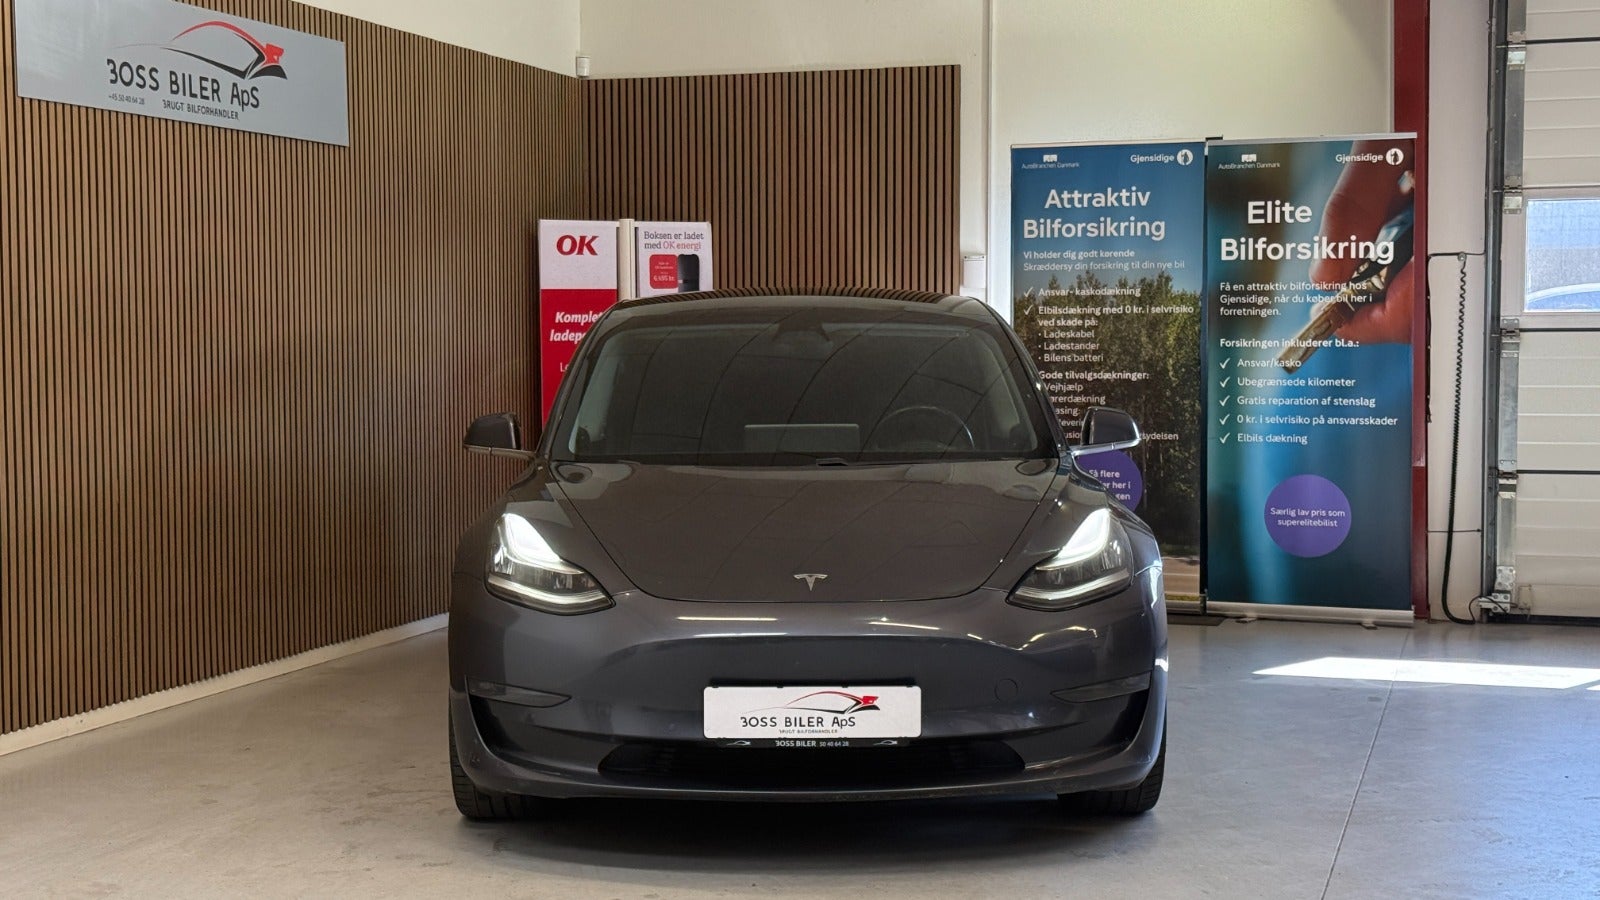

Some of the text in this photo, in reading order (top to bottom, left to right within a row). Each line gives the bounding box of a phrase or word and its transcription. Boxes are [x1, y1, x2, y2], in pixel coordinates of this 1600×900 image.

[168, 70, 221, 102] BILER
[231, 82, 260, 112] ApS
[187, 103, 240, 120] BILFORHANDLER
[1130, 153, 1175, 164] Gjensidige
[1336, 154, 1383, 164] Gjensidige
[1044, 186, 1151, 209] Attraktiv
[1247, 200, 1313, 224] Elite
[1023, 215, 1166, 241] Bilforsikring
[643, 231, 673, 240] Boksen
[684, 231, 705, 240] ladet
[556, 234, 600, 256] OK
[644, 241, 702, 252] med OK energi
[1220, 236, 1394, 265] Bilforsikring
[1024, 249, 1135, 261] Vi holder dig godt kørende
[1023, 260, 1185, 272] Skræddersy din forsikring til din nye bil
[1038, 287, 1141, 297] Ansvar- kaskodækning
[1220, 282, 1232, 291] Få
[1246, 282, 1288, 291] attraktiv
[1290, 282, 1346, 292] bilforsikring
[1350, 282, 1367, 290] hos
[1220, 294, 1272, 304] Gjensidige,
[1274, 294, 1290, 303] når
[1292, 294, 1304, 302] du
[1306, 294, 1334, 302] køber
[1336, 294, 1348, 302] bil
[1350, 294, 1368, 302] her
[1038, 306, 1101, 316] Elbilsdækning
[1102, 306, 1123, 314] med
[1125, 306, 1131, 314] 0
[1132, 306, 1144, 314] kr.
[1151, 306, 1194, 314] selvrisiko
[1220, 307, 1282, 317] forretningen.
[1038, 318, 1098, 328] ved skade på:
[1044, 330, 1095, 338] Ladeskabel
[1044, 342, 1100, 350] Ladestander
[1220, 338, 1280, 349] Forsikringen
[1282, 338, 1333, 348] inkluderer
[1237, 358, 1302, 368] Ansvar/kasko
[1038, 370, 1150, 381] Gode tilvalgsdækninger:
[1238, 377, 1356, 388] Ubegrænsede kilometer
[1237, 396, 1376, 408] Gratis reparation af stenslag
[1237, 415, 1244, 424] 0
[1246, 415, 1258, 424] kr.
[1265, 415, 1310, 424] selvrisiko
[1312, 415, 1325, 426] på
[1327, 416, 1398, 426] ansvarsskader
[1238, 433, 1308, 445] Elbils dækning
[1100, 469, 1120, 478] flere
[1270, 508, 1296, 518] Særlig
[1298, 508, 1309, 516] lav
[1311, 508, 1326, 518] pris
[1278, 518, 1338, 528] superelitebilist
[784, 716, 824, 728] BILER
[831, 716, 856, 729] ApS
